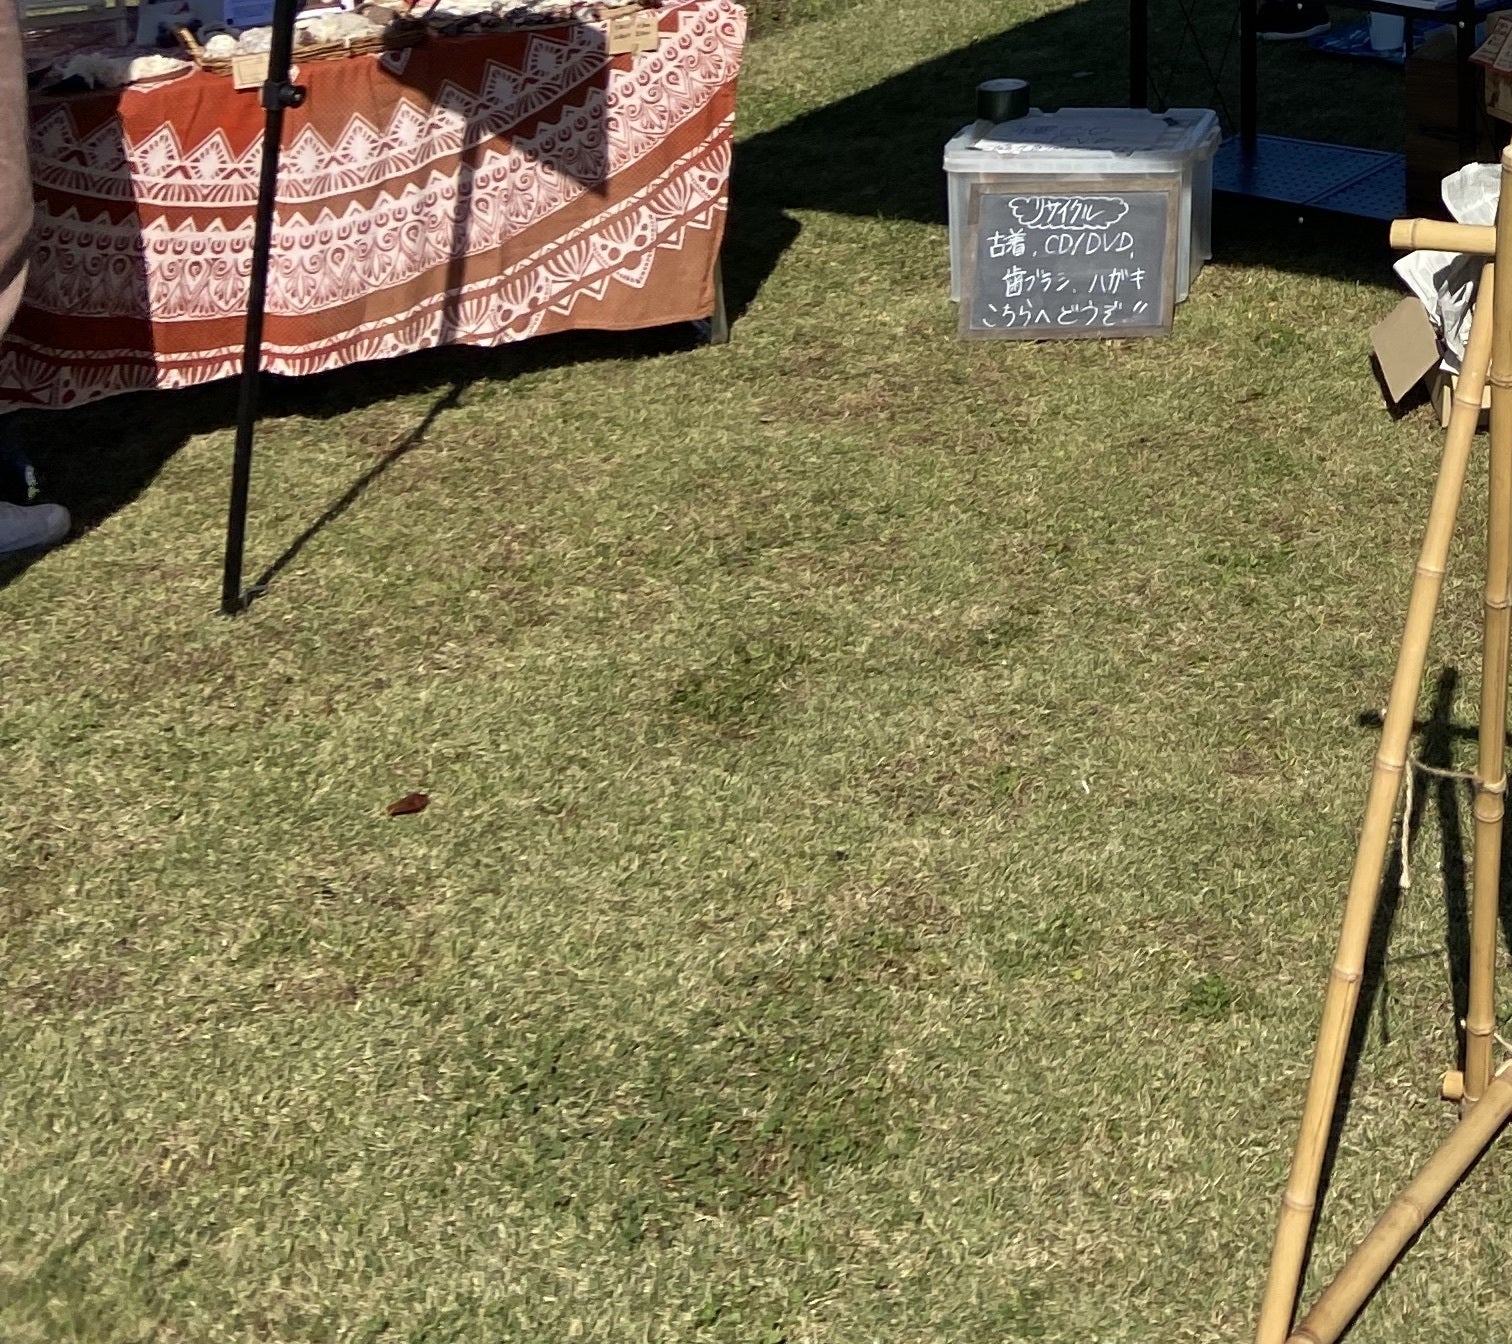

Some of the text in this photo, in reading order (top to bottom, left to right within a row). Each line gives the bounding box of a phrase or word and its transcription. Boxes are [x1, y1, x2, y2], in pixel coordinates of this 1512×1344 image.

[1030, 197, 1105, 225] リサイクル
